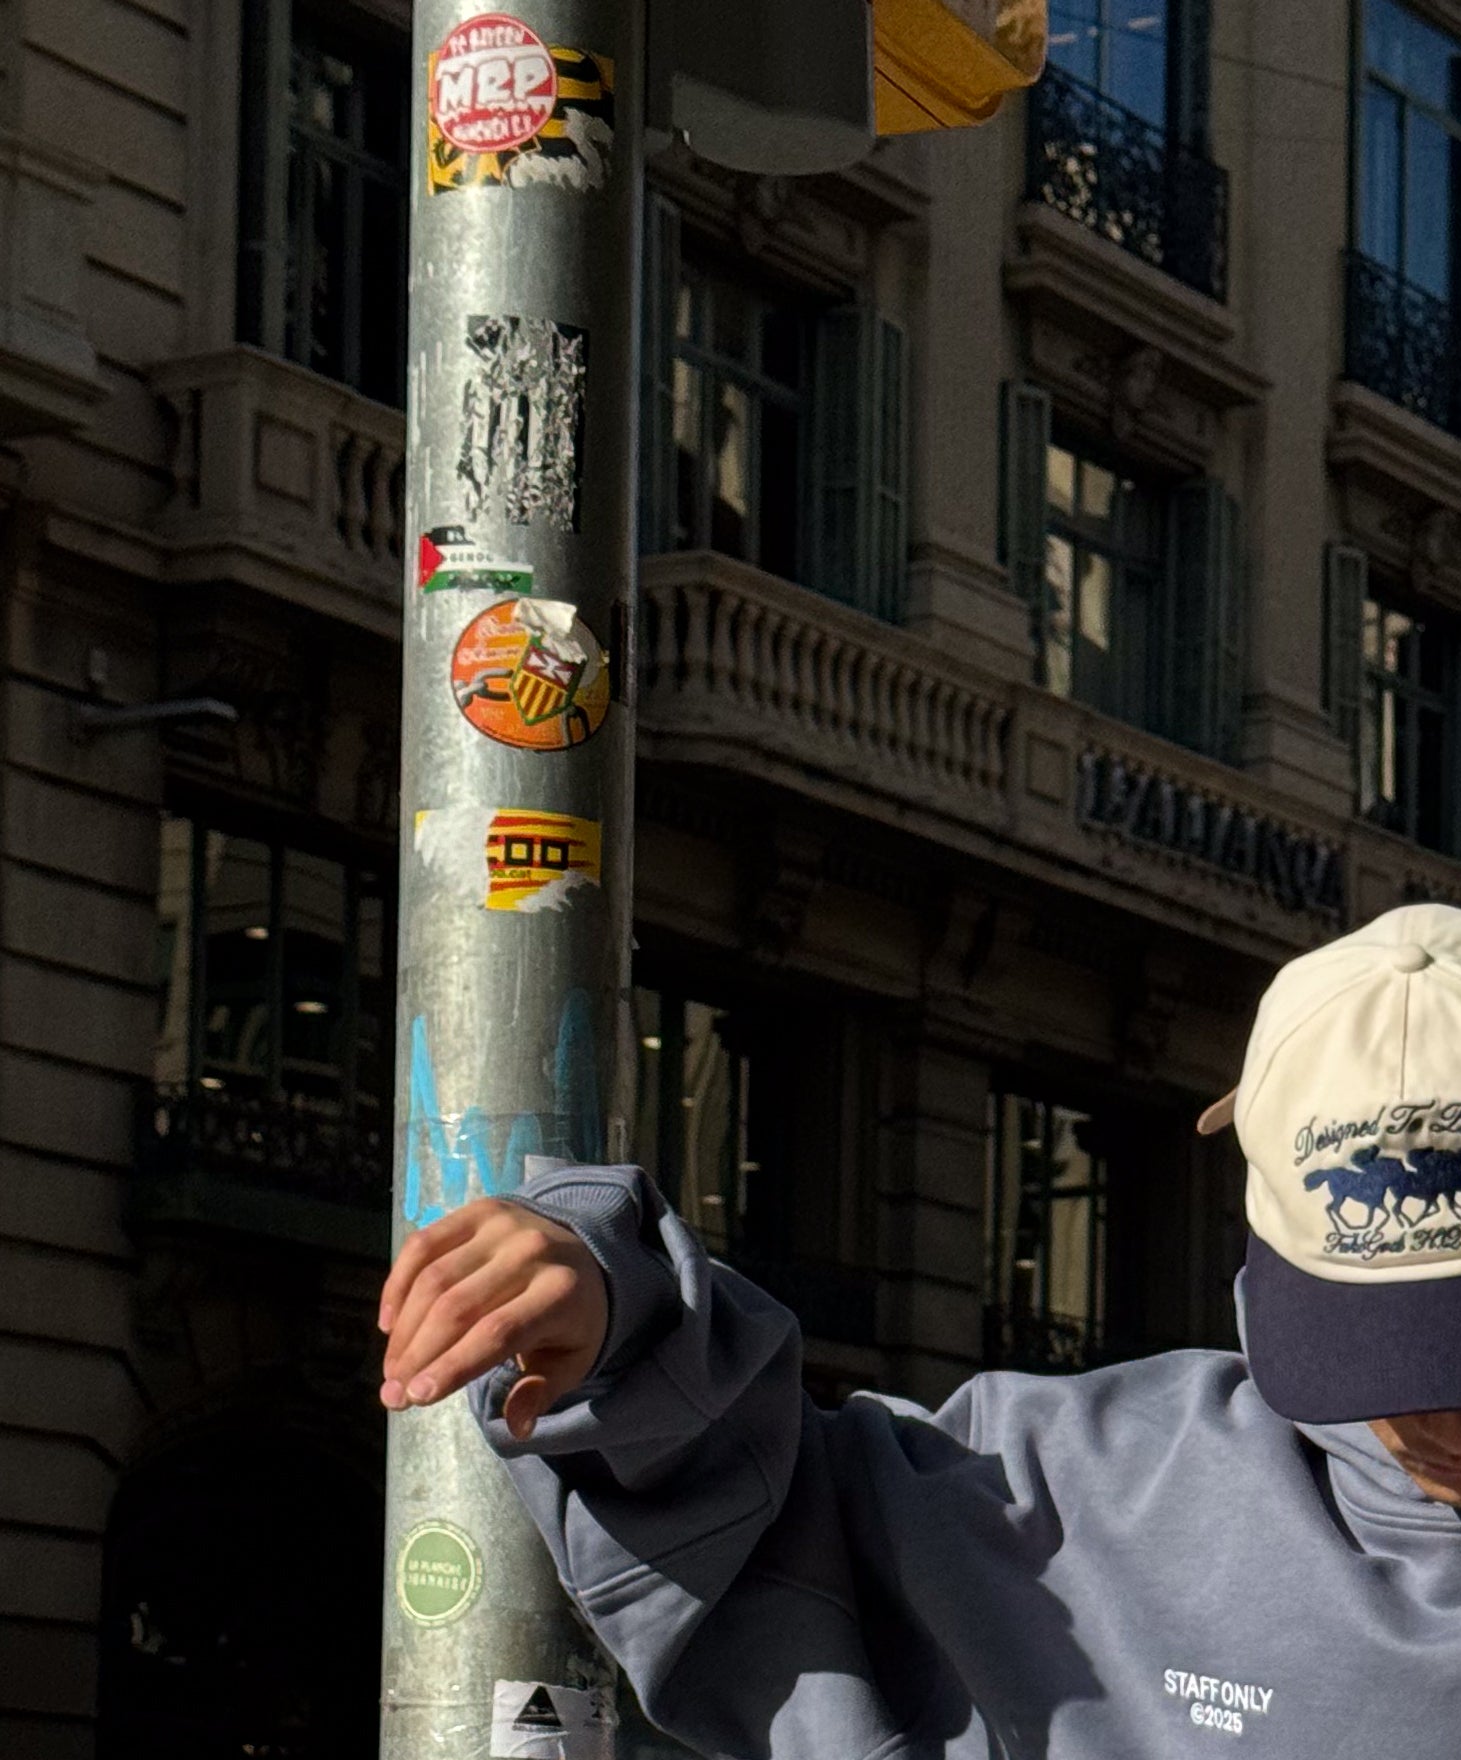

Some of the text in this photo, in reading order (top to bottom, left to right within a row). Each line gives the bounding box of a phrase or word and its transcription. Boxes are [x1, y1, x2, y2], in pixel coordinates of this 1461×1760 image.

[1294, 1107, 1386, 1166] Designed
[1386, 1099, 1436, 1134] To
[1190, 1702, 1243, 1735] ©2025
